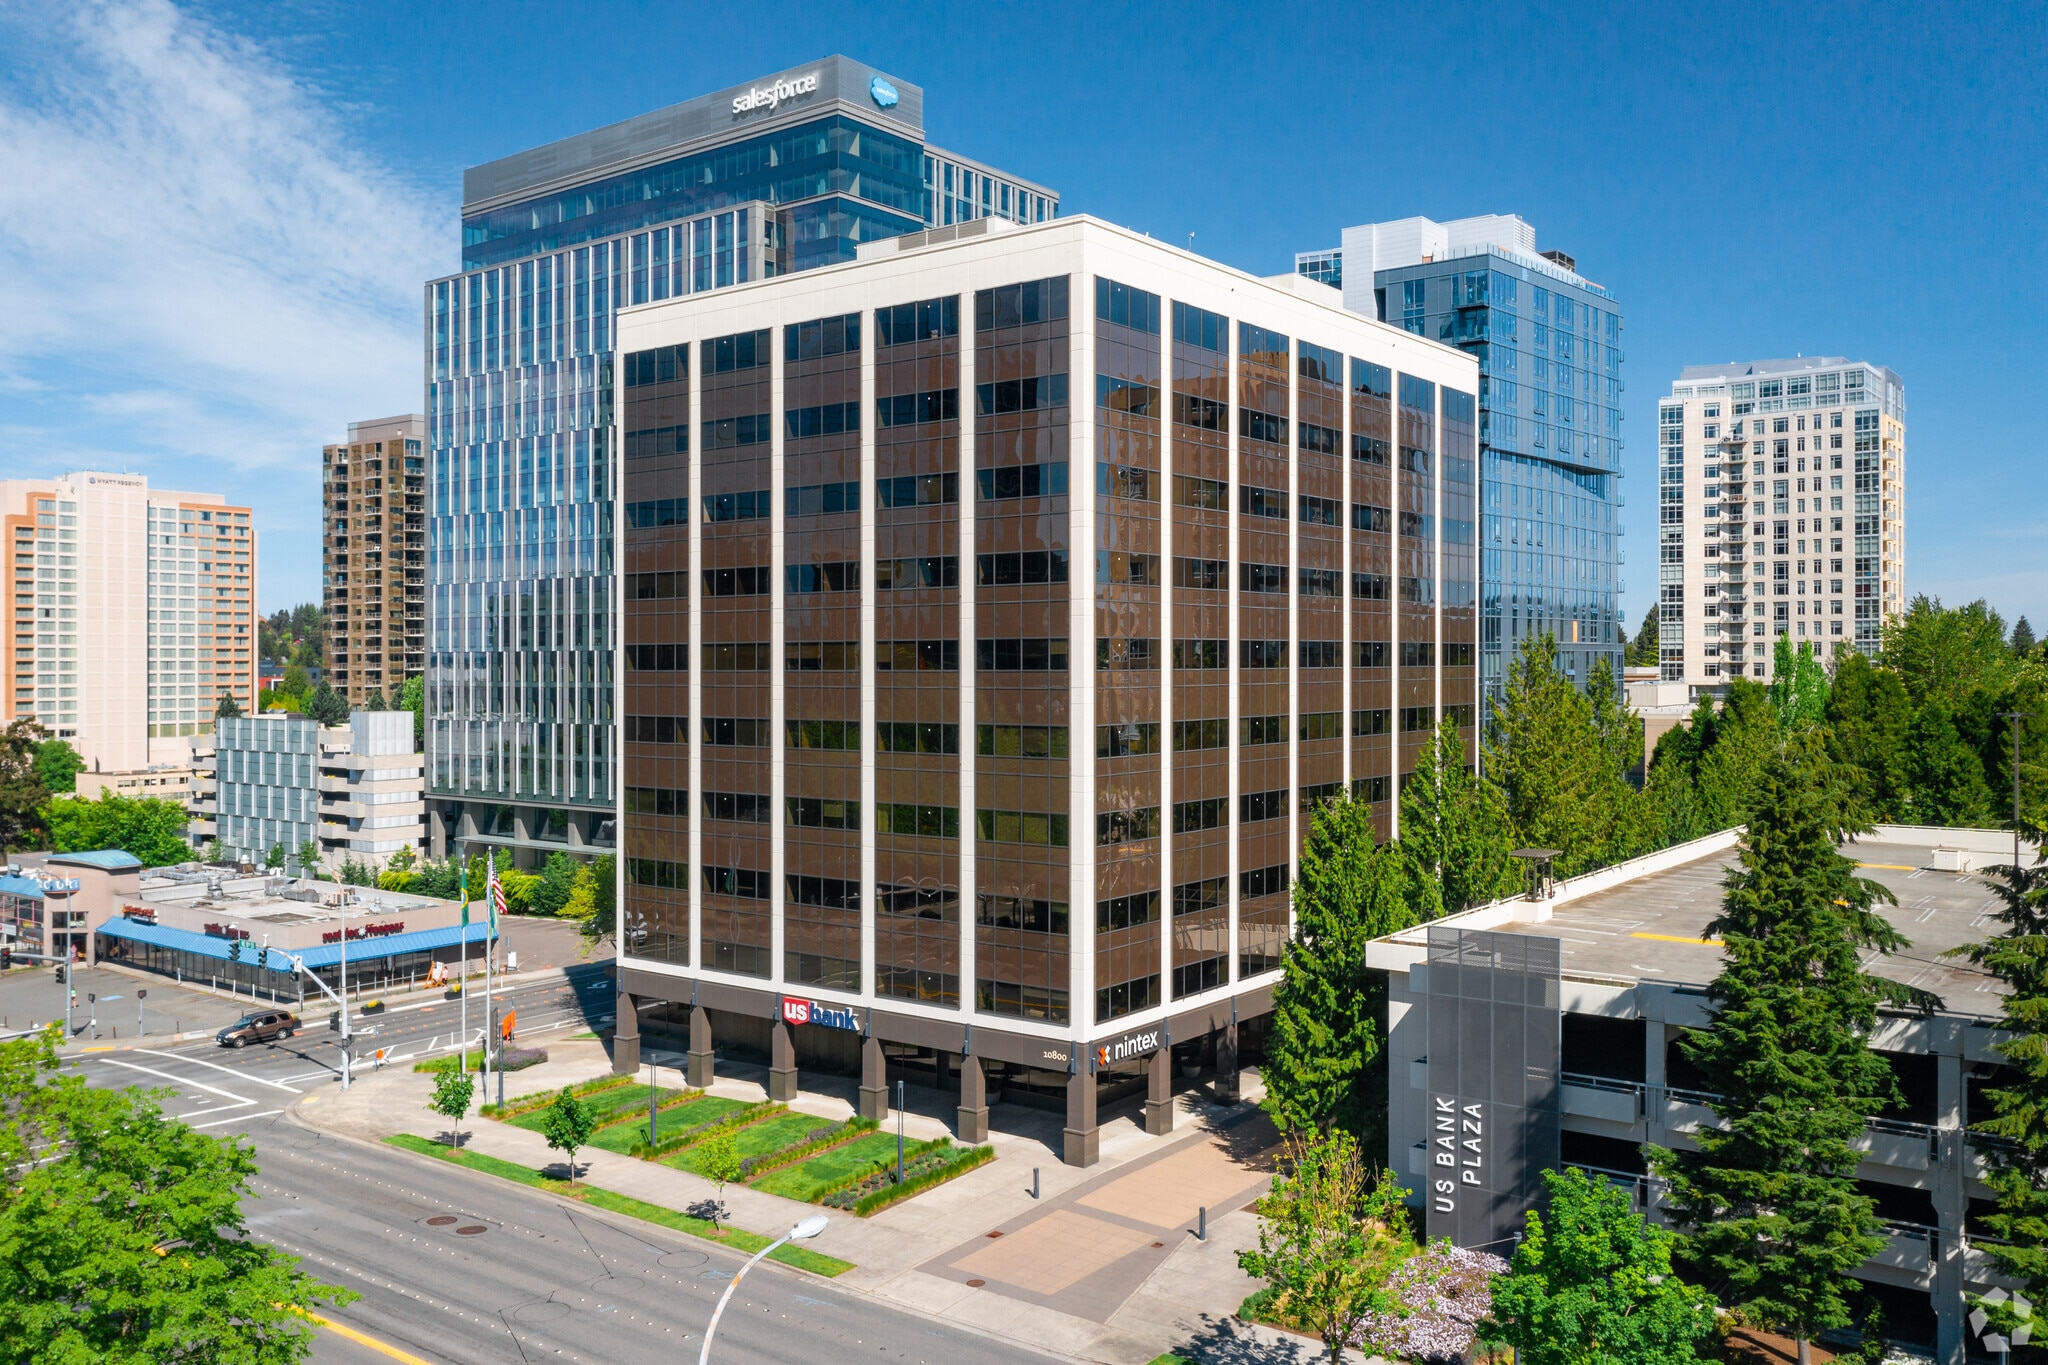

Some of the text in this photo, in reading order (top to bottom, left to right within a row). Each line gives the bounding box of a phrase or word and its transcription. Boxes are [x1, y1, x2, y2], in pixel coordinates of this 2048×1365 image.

[732, 75, 817, 114] salesforce
[784, 1001, 860, 1031] us bank
[1043, 1050, 1067, 1062] 10800
[1114, 1031, 1158, 1060] nintex
[1435, 1097, 1455, 1213] US BANK
[1462, 1103, 1482, 1186] PLAZA
